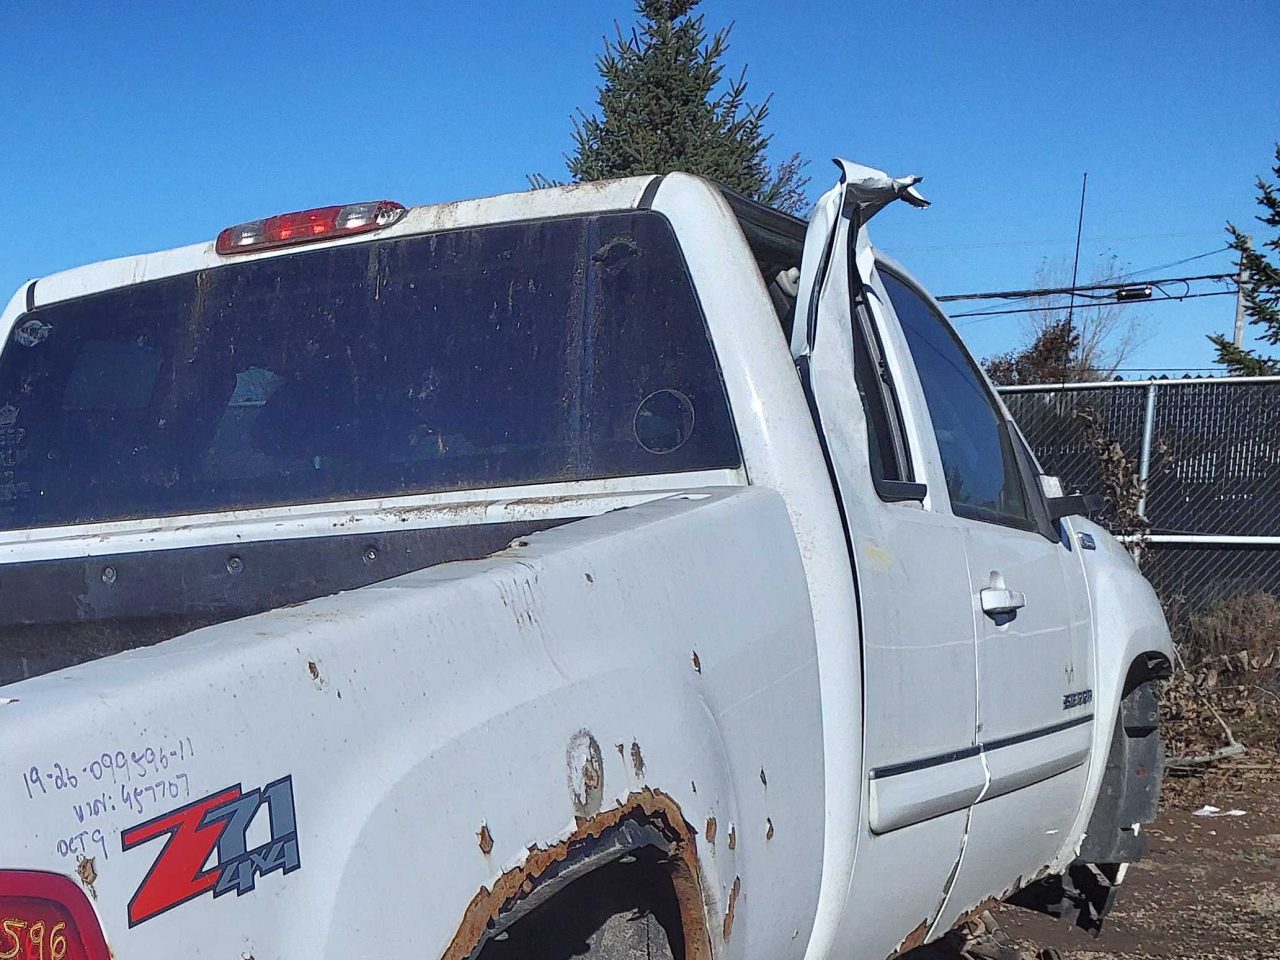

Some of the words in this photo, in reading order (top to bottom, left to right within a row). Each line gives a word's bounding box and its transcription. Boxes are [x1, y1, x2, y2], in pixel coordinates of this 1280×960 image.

[121, 773, 191, 814] 457707
[56, 830, 89, 858] OCT
[91, 828, 109, 860] 9
[121, 774, 300, 929] Z71
